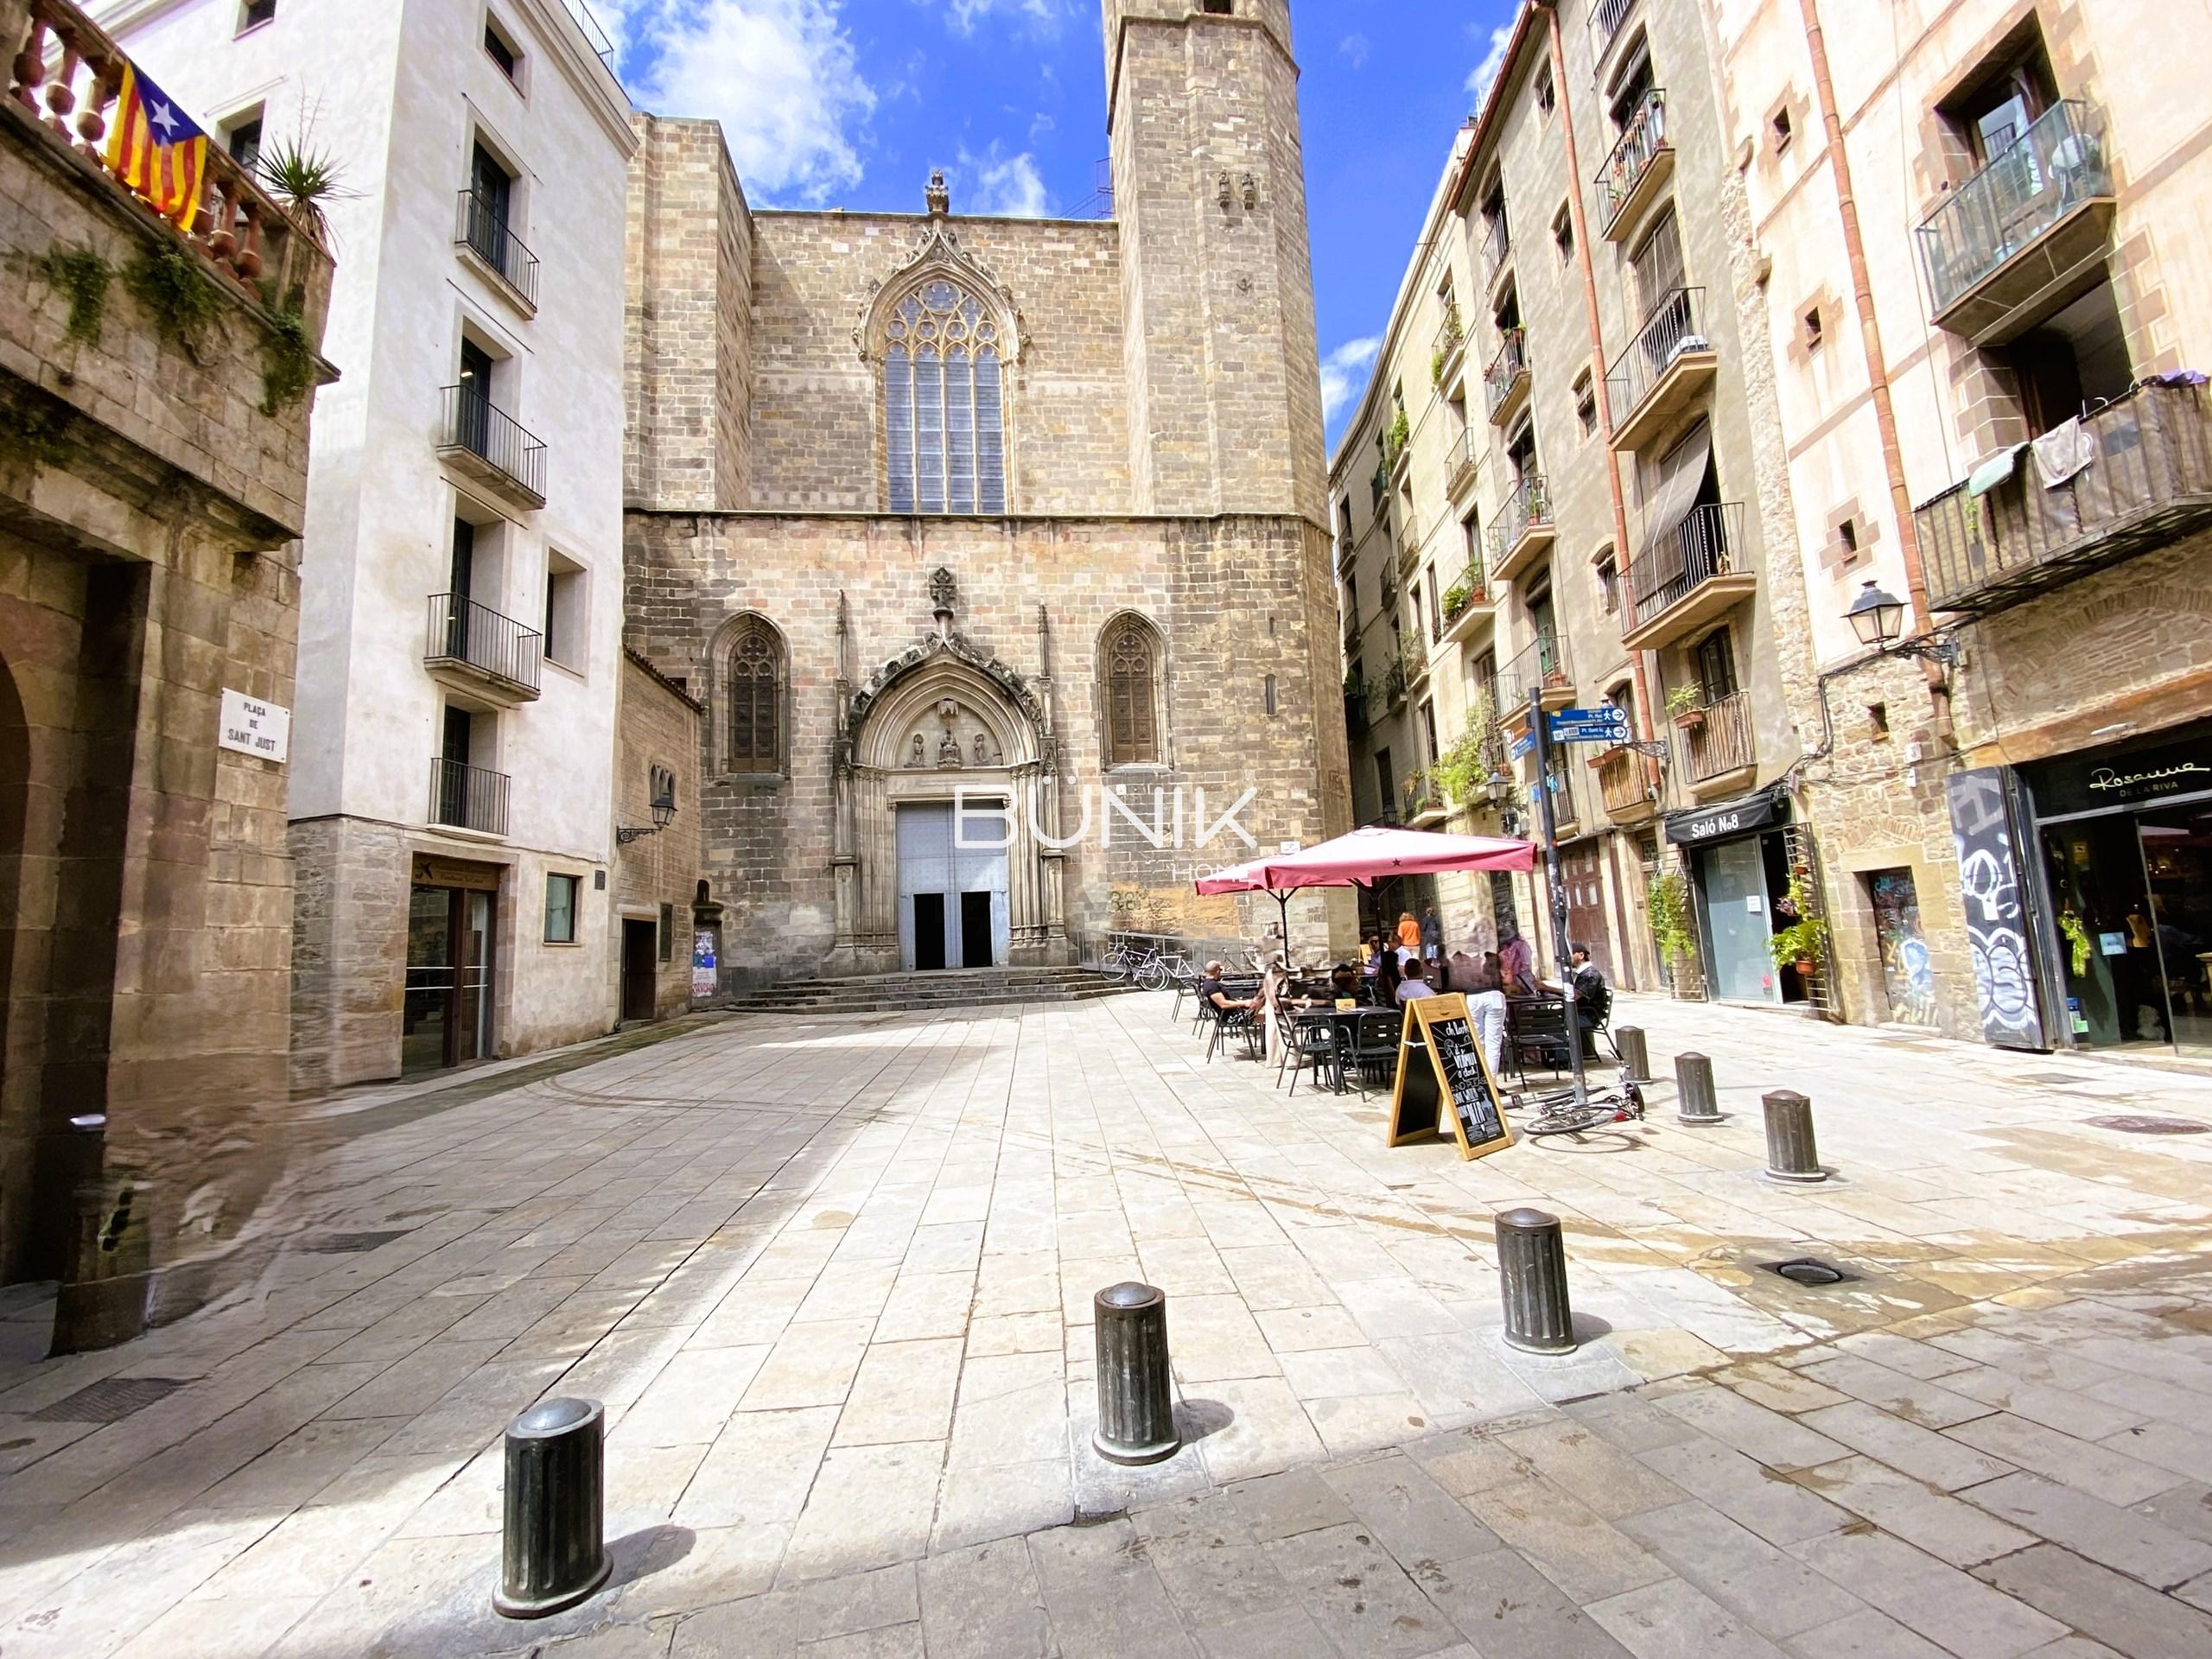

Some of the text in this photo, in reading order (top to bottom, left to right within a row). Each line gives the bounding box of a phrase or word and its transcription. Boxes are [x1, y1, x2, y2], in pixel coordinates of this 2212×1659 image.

[243, 702, 266, 717] PLAÇA
[249, 719, 258, 729] DE
[227, 728, 276, 752] SANT JUST
[2120, 781, 2178, 797] DE LA RIVA
[1692, 817, 1716, 838] Saló
